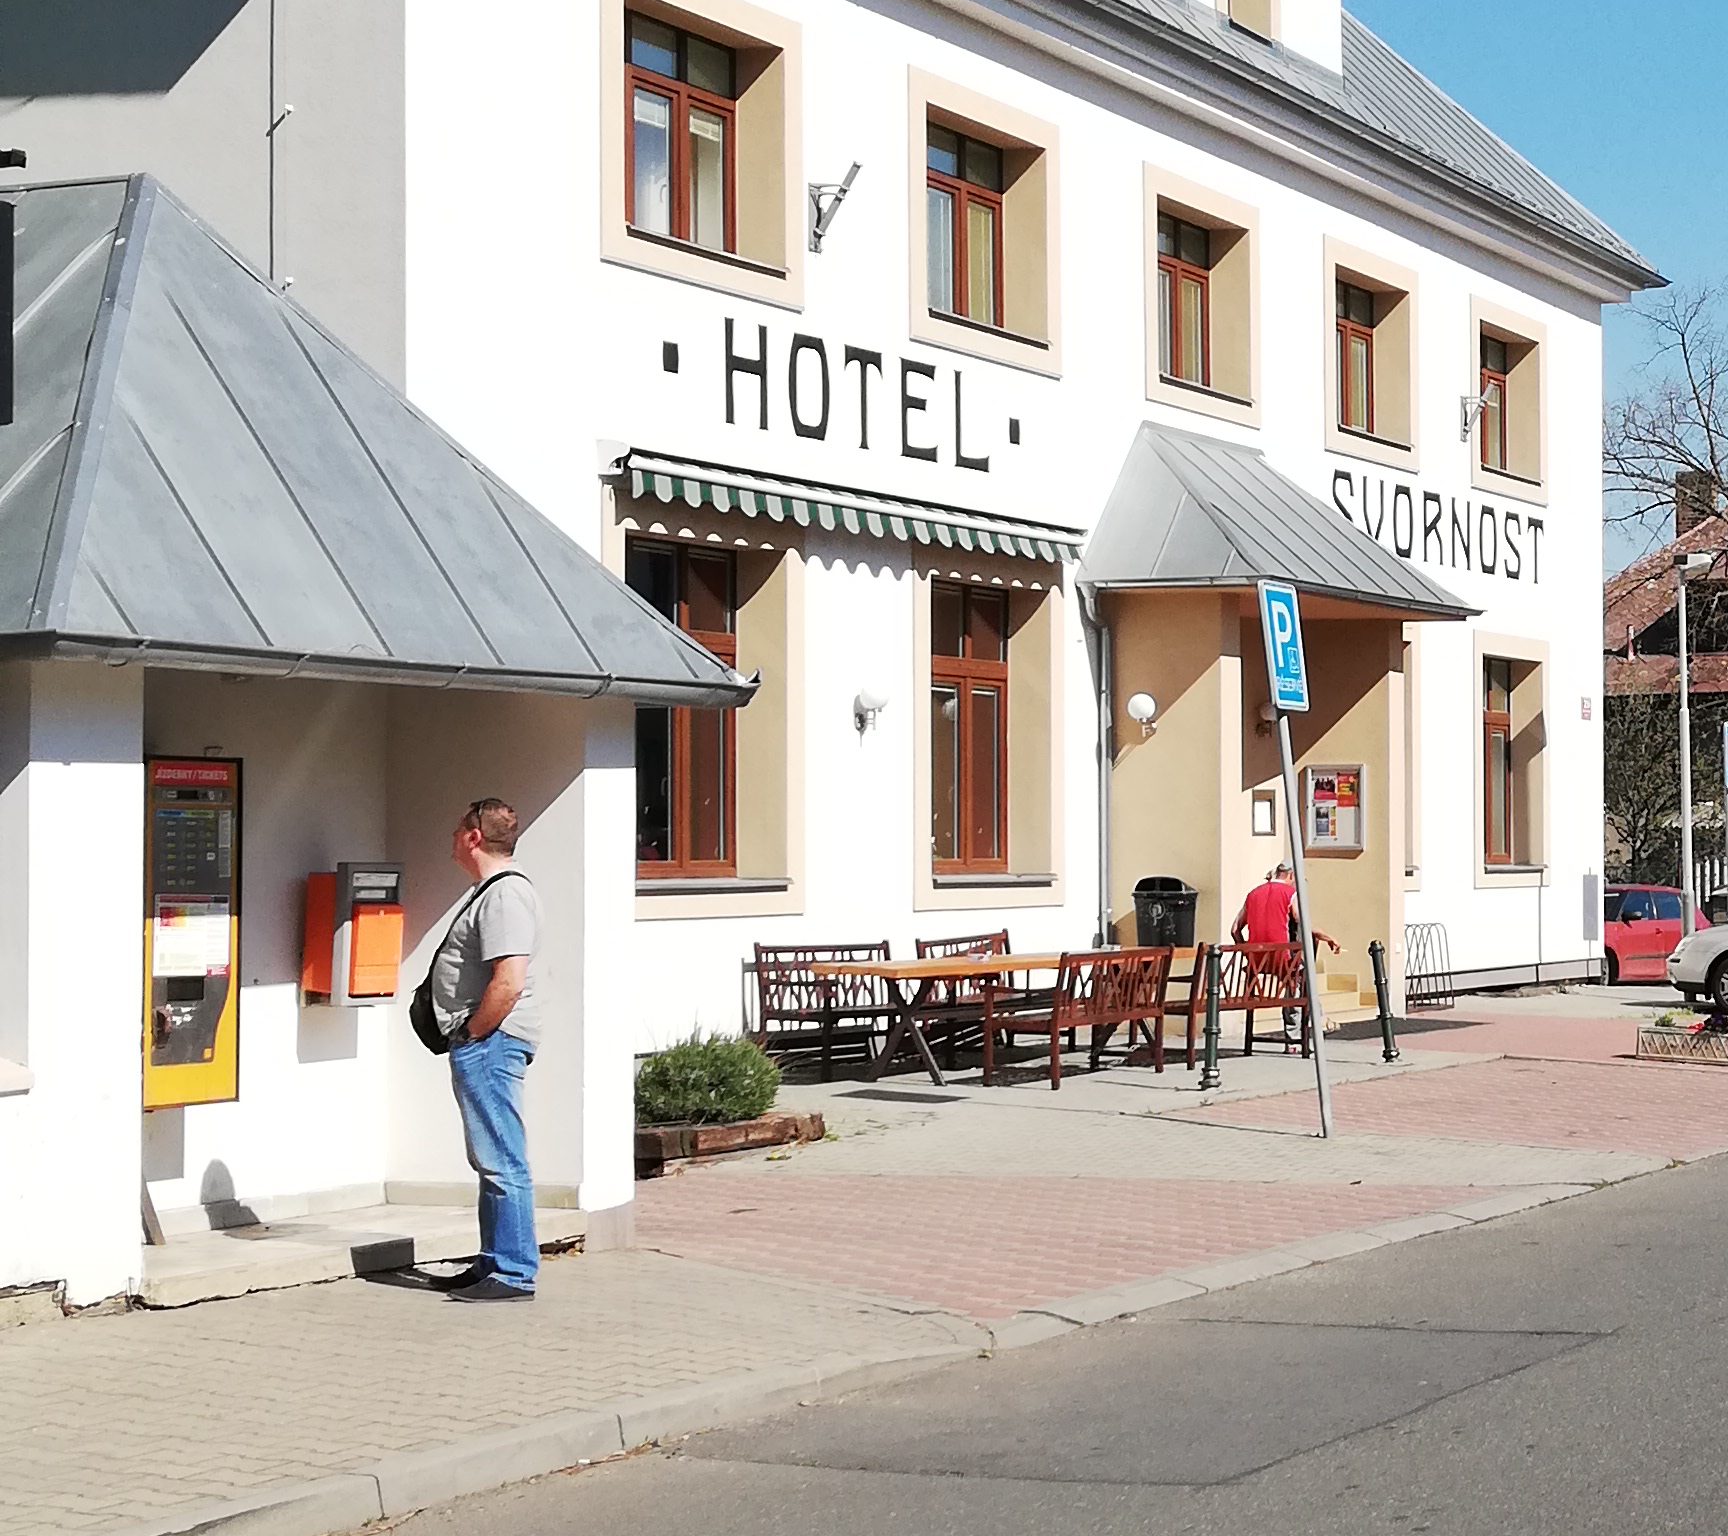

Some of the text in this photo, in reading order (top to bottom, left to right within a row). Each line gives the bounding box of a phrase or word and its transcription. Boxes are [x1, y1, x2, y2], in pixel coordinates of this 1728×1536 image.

[725, 317, 1545, 584] HOTEL SVORNOST
[1271, 600, 1293, 668] P
